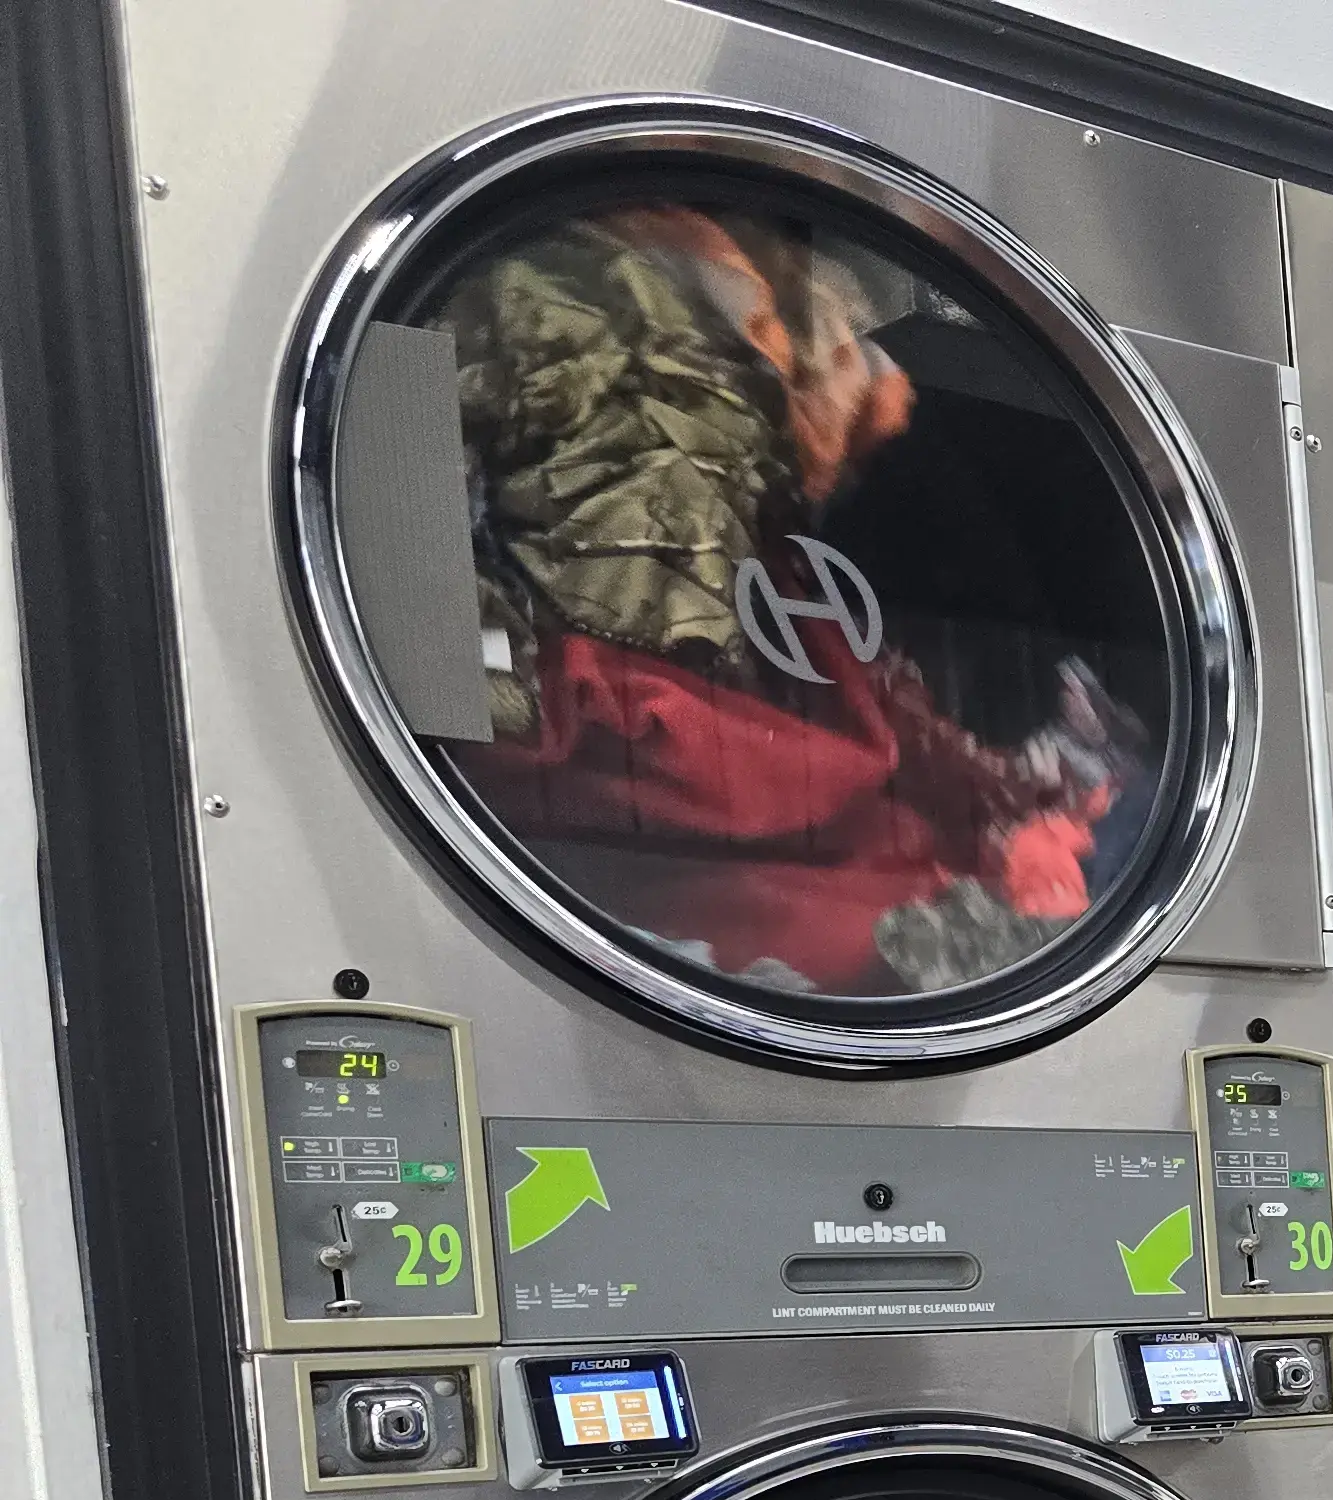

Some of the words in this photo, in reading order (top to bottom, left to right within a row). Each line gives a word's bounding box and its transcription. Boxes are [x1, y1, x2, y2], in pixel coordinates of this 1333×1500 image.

[340, 1053, 378, 1077] 24
[1224, 1084, 1247, 1103] 25
[813, 1221, 947, 1244] Huebsch
[391, 1223, 463, 1286] 29
[1287, 1221, 1333, 1271] 30
[772, 1307, 795, 1318] LINT
[798, 1305, 876, 1317] COMPARTMENT
[878, 1304, 907, 1315] MUST
[908, 1304, 922, 1314] BE
[923, 1303, 967, 1313] CLEANED
[969, 1302, 996, 1312] DAILY
[1155, 1332, 1200, 1343] FASCARD
[1165, 1348, 1196, 1360] $0.25
[571, 1358, 630, 1371] FASCARD
